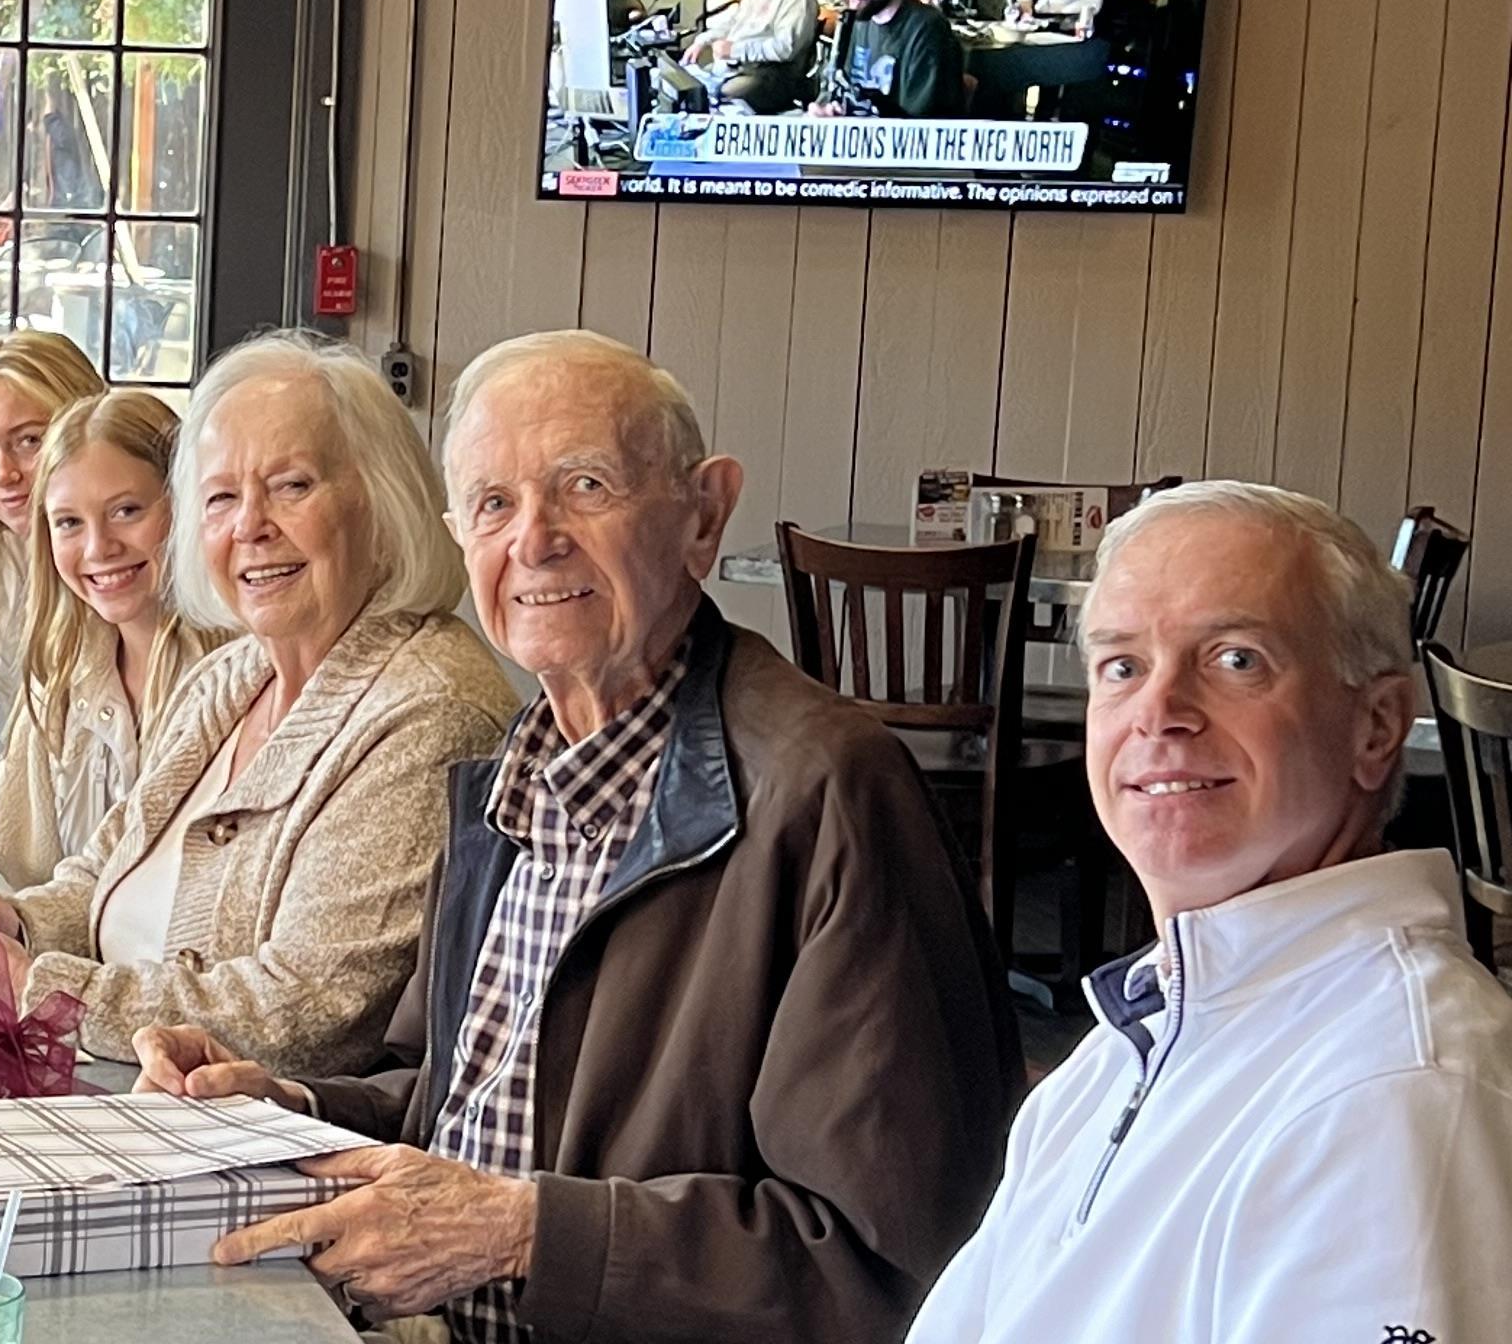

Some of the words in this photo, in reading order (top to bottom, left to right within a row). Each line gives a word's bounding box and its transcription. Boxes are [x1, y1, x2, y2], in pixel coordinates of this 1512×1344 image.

[714, 123, 779, 156] BRAND
[784, 124, 827, 158] NEW
[832, 125, 887, 159] LIONS
[891, 126, 930, 160] WIN
[935, 127, 968, 161] THE
[971, 128, 1008, 162] NFC
[1012, 129, 1075, 164] NORTH
[1111, 161, 1171, 184] ESPN
[667, 177, 681, 193] It
[683, 177, 697, 194] is
[700, 179, 752, 196] meant
[754, 180, 773, 197] to
[775, 179, 797, 197] be
[800, 179, 868, 199] comedic
[870, 181, 963, 200] informative.
[966, 182, 997, 201] The
[999, 184, 1068, 206] opinions
[1070, 187, 1150, 207] expressed
[1151, 190, 1174, 205] on
